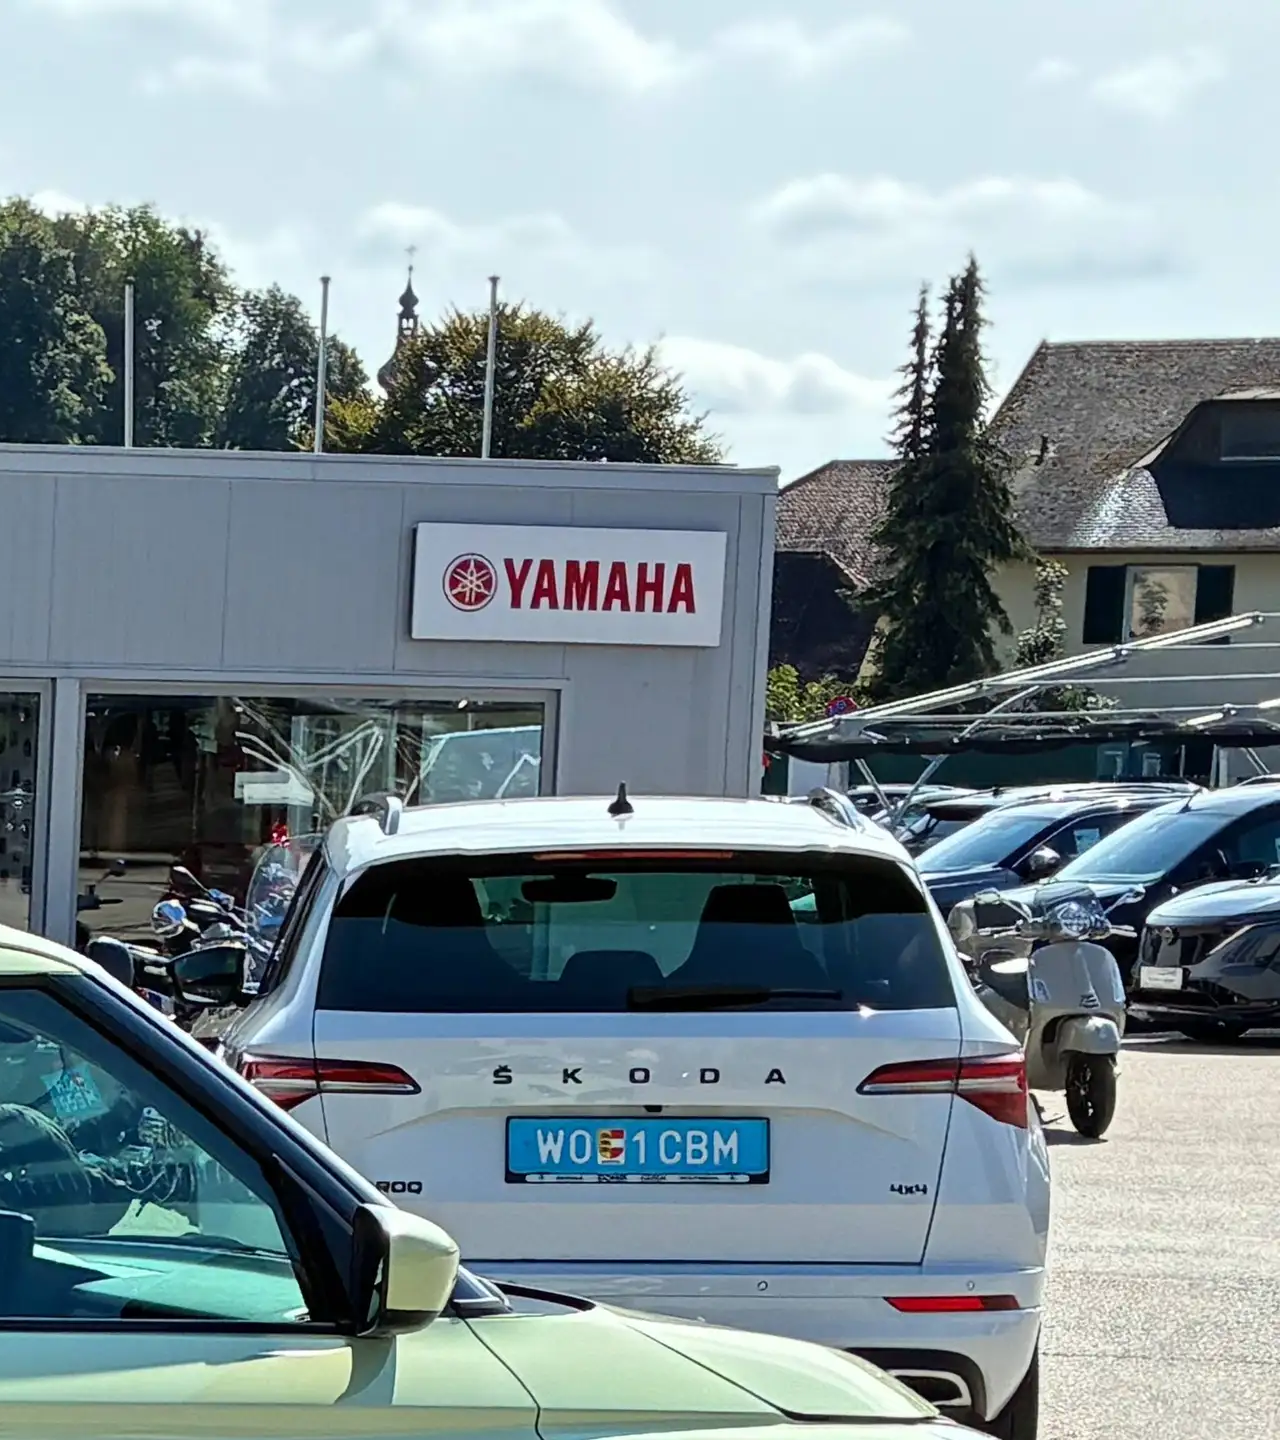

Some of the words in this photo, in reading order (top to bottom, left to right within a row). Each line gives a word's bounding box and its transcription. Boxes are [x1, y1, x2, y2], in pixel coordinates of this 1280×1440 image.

[503, 558, 696, 614] YAMAHA
[493, 1064, 787, 1086] ŠKODA
[536, 1129, 593, 1165] WO
